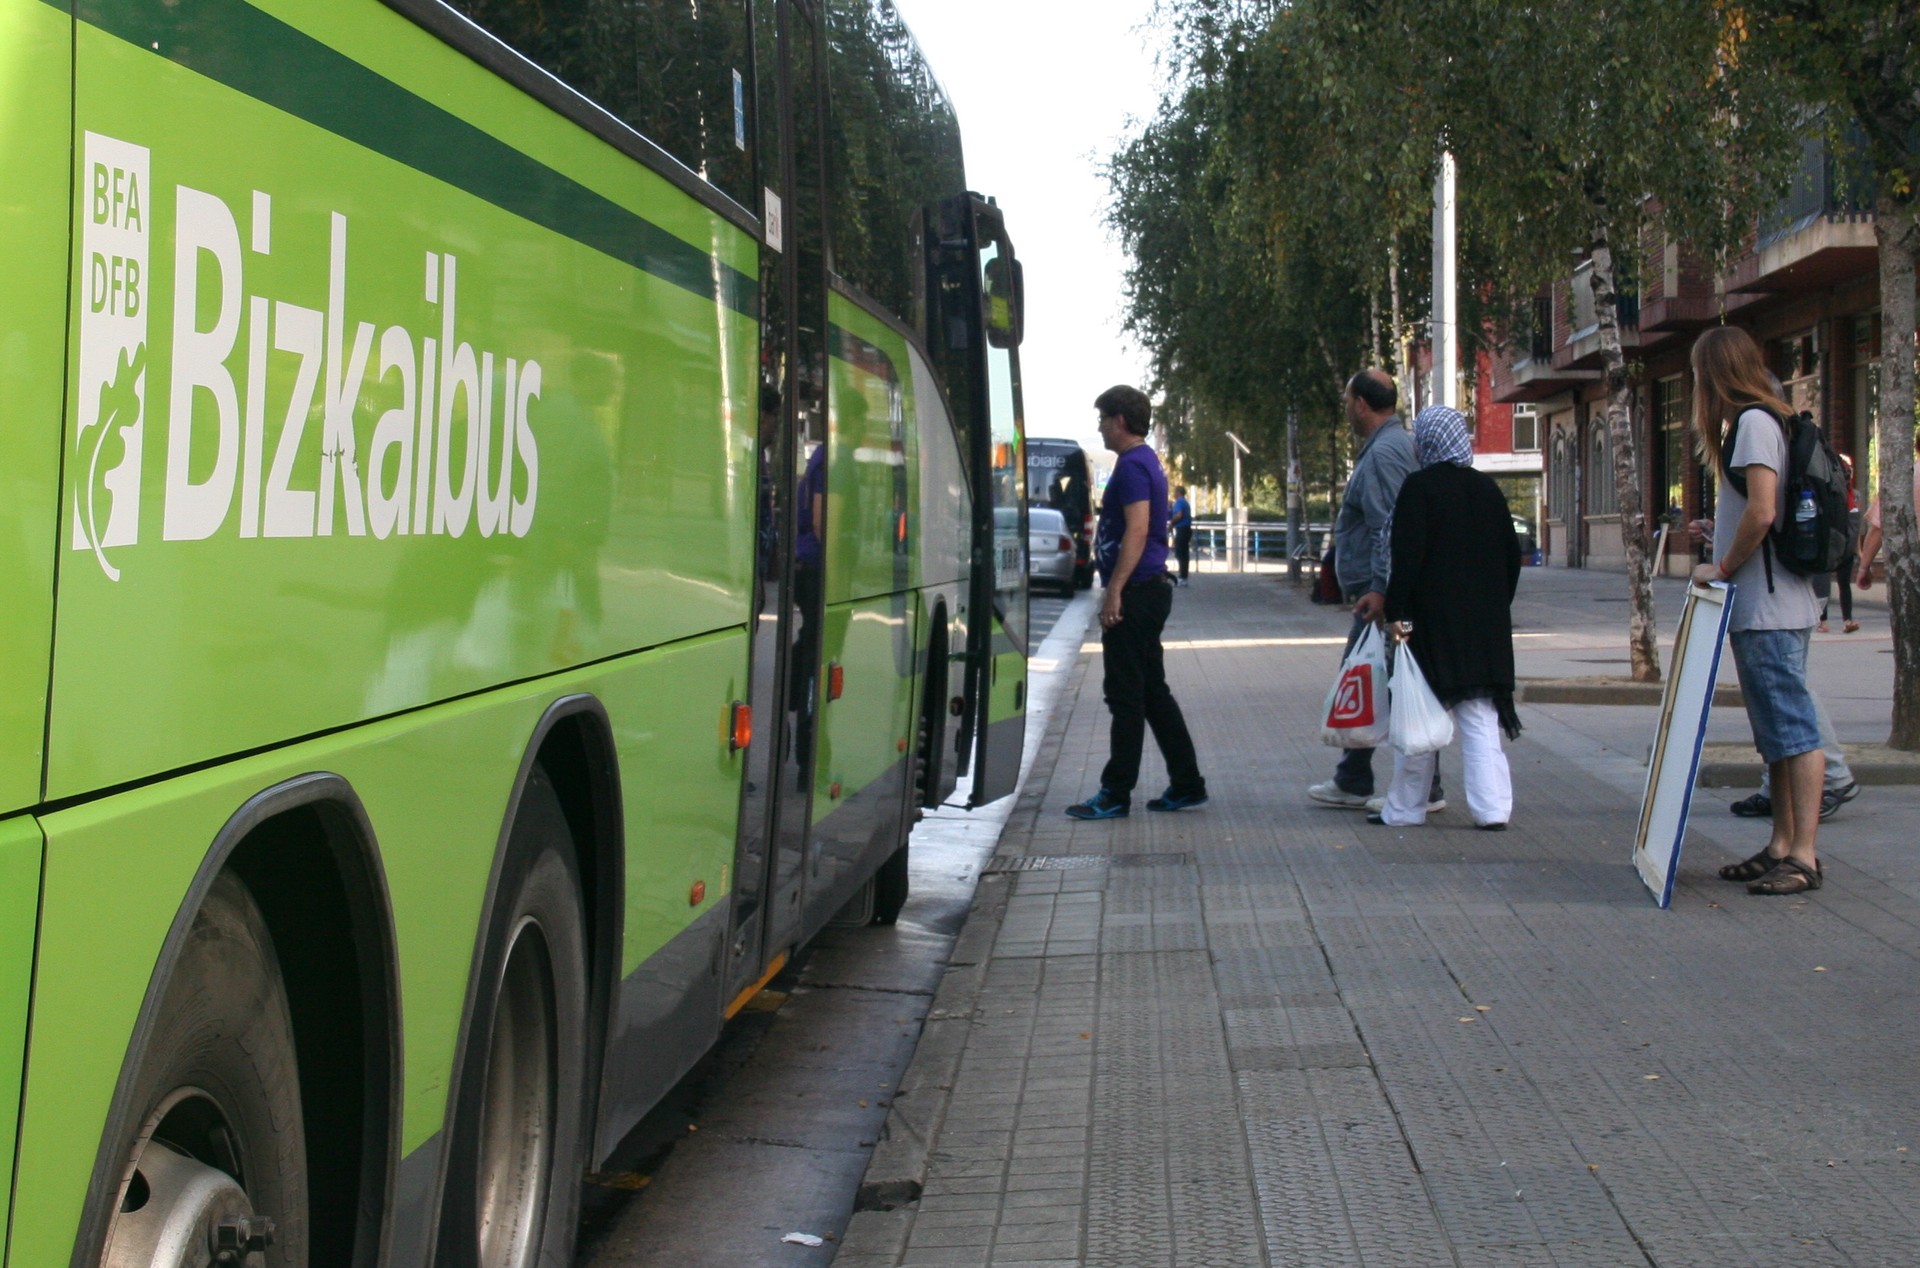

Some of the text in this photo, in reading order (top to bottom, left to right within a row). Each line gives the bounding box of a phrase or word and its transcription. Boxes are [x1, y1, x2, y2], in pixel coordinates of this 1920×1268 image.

[93, 161, 142, 233] BFA
[91, 251, 140, 318] DFB
[163, 184, 542, 541] Bizkaibus
